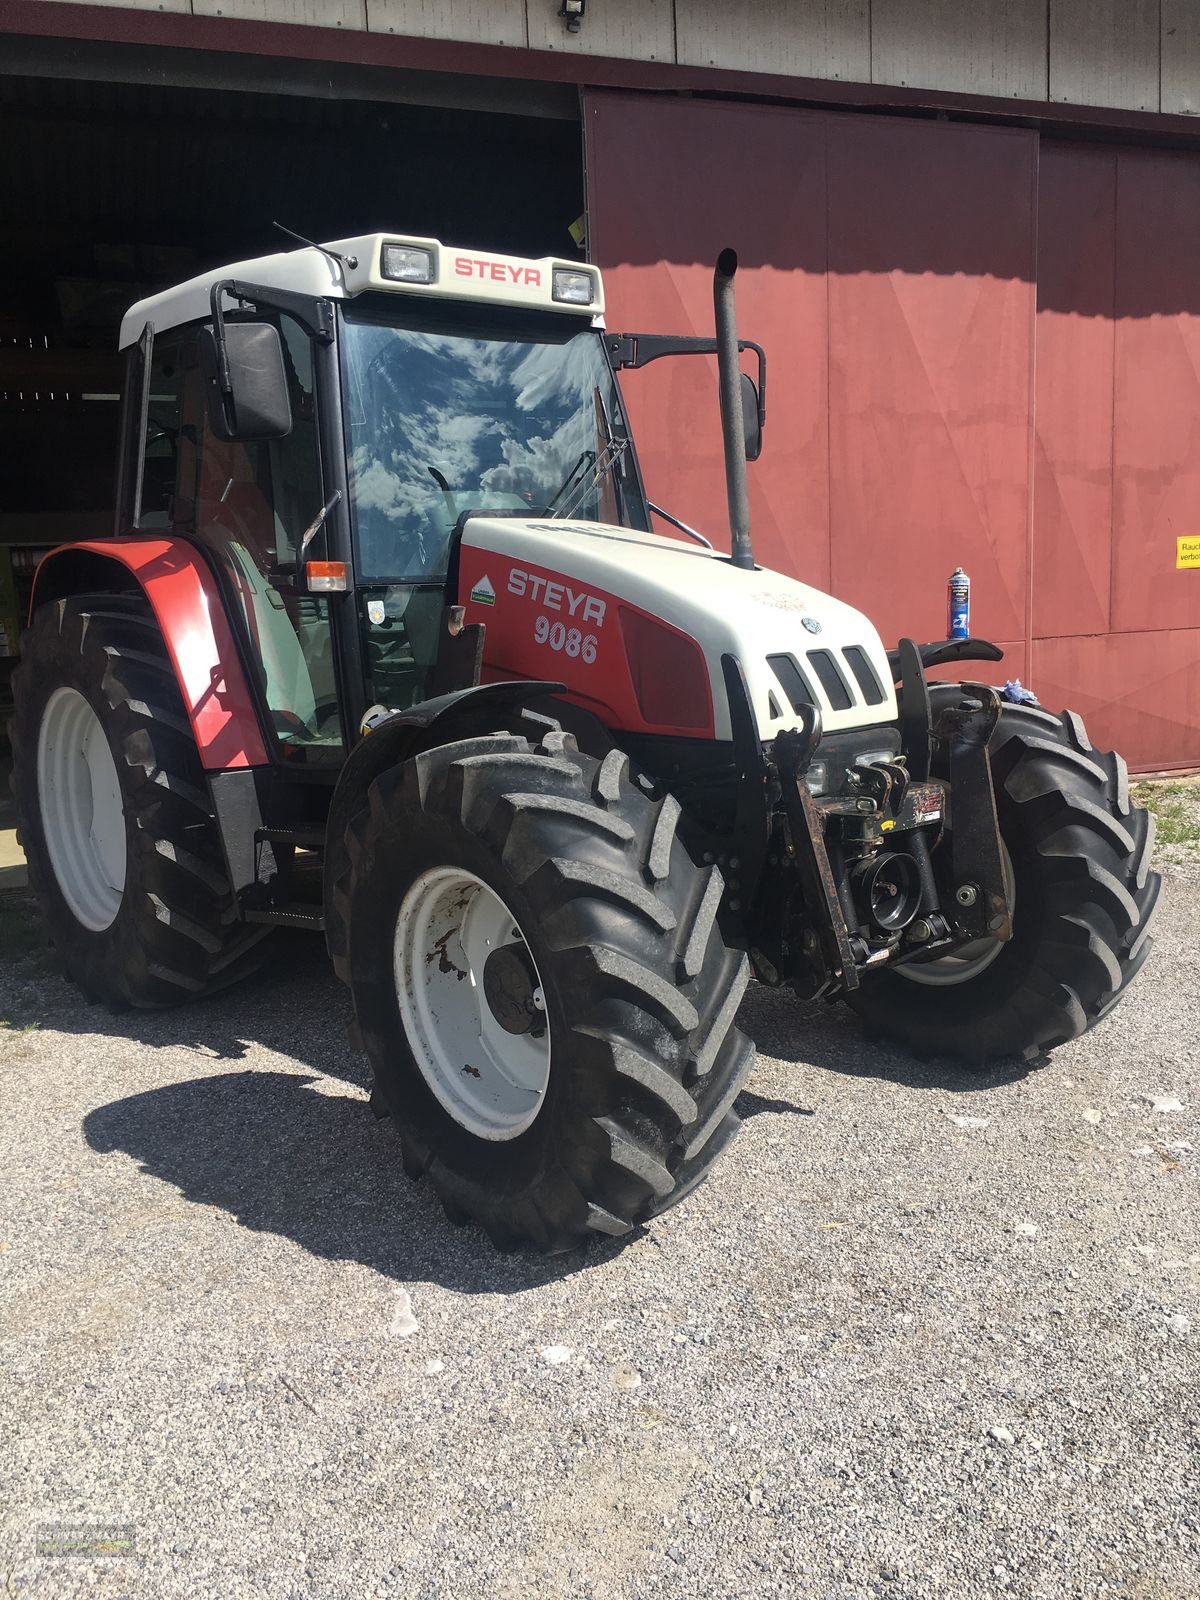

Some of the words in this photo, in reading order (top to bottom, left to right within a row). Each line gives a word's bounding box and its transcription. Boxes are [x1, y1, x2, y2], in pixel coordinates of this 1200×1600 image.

[455, 257, 541, 287] STEYR
[1181, 553, 1200, 561] verbo
[507, 568, 607, 628] STEYR
[534, 615, 598, 664] 9086
